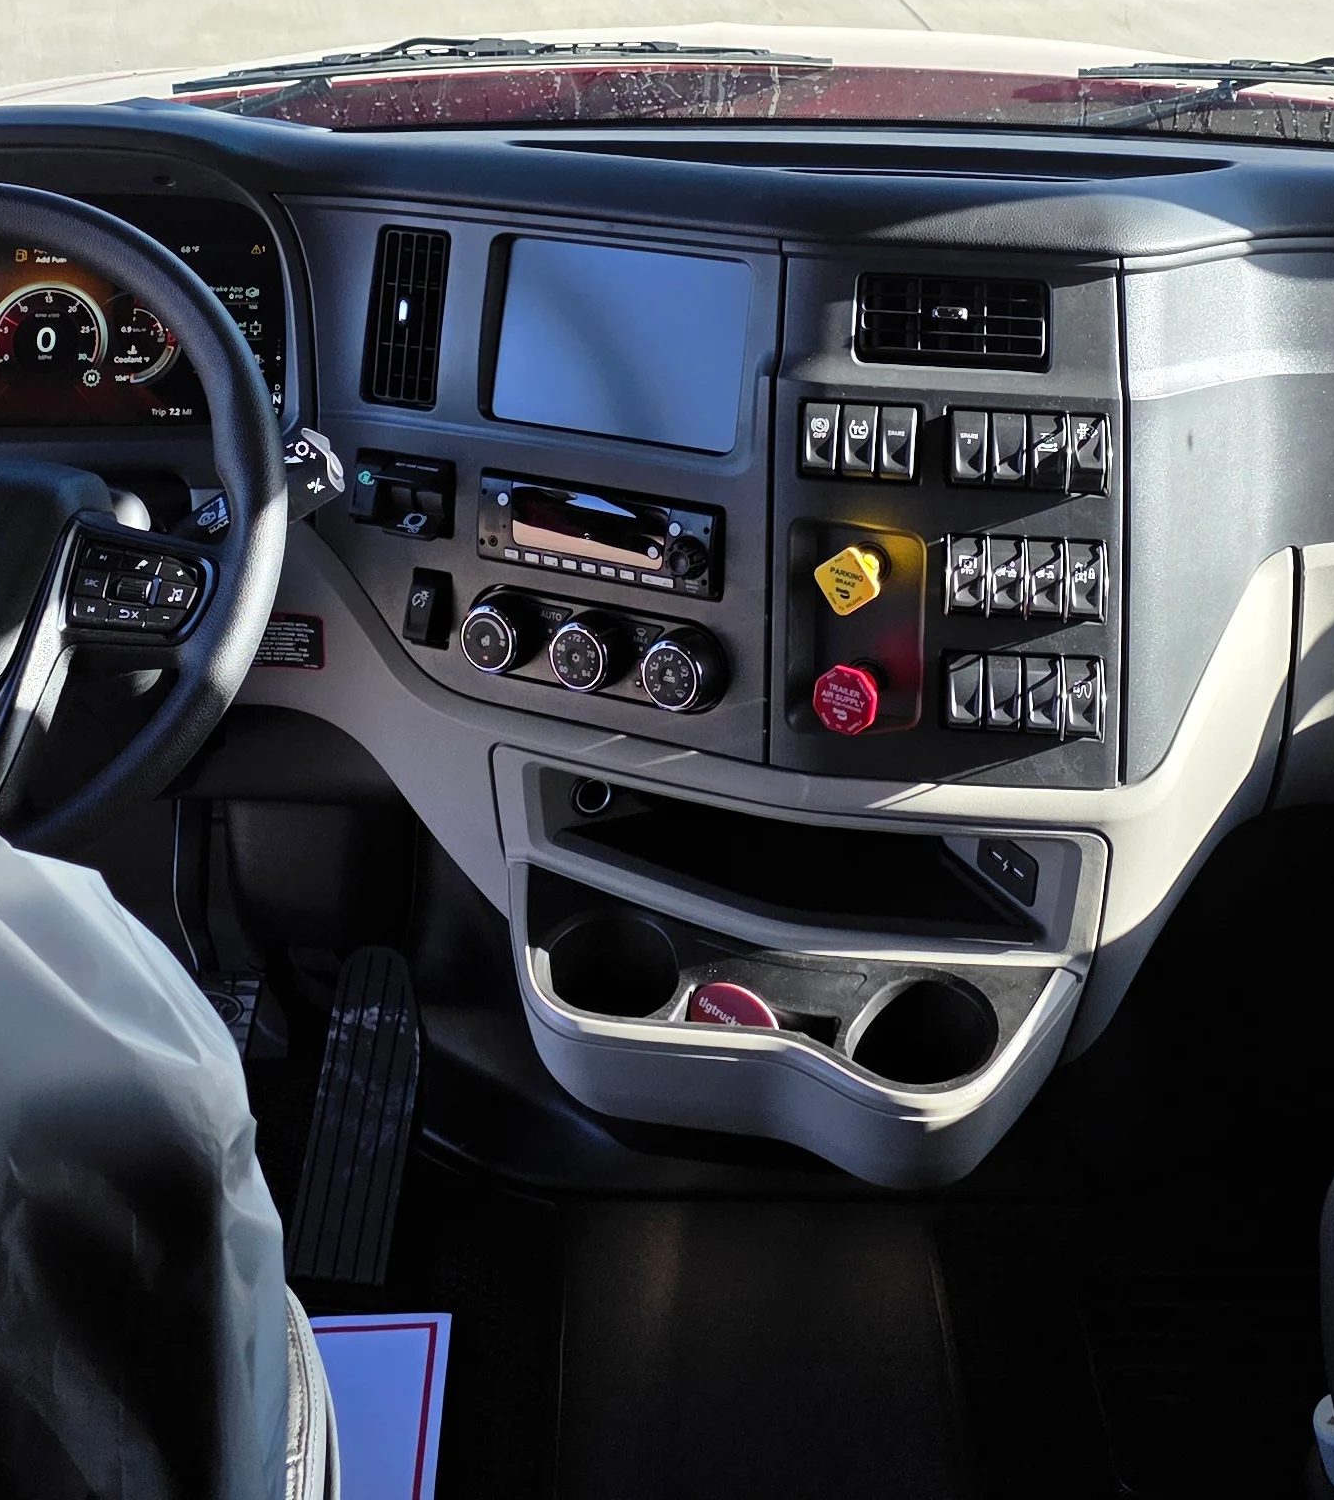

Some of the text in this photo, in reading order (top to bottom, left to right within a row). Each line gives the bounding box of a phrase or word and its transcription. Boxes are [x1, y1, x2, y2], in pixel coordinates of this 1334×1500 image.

[36, 326, 56, 353] 0
[113, 355, 143, 364] Coolant
[87, 374, 96, 382] N
[272, 394, 281, 405] N
[151, 408, 167, 417] Trip
[812, 431, 827, 439] OFF
[852, 426, 866, 435] TC
[887, 429, 906, 437] SPARE
[208, 518, 230, 534] MAX
[830, 566, 864, 583] PARKING
[960, 567, 975, 575] PTO
[83, 579, 99, 589] SRC
[835, 577, 856, 588] BRAKE
[540, 609, 563, 622] AUTO
[571, 633, 582, 643] 72
[828, 682, 861, 699] TRAILER
[821, 689, 865, 708] AIR SUPPLY
